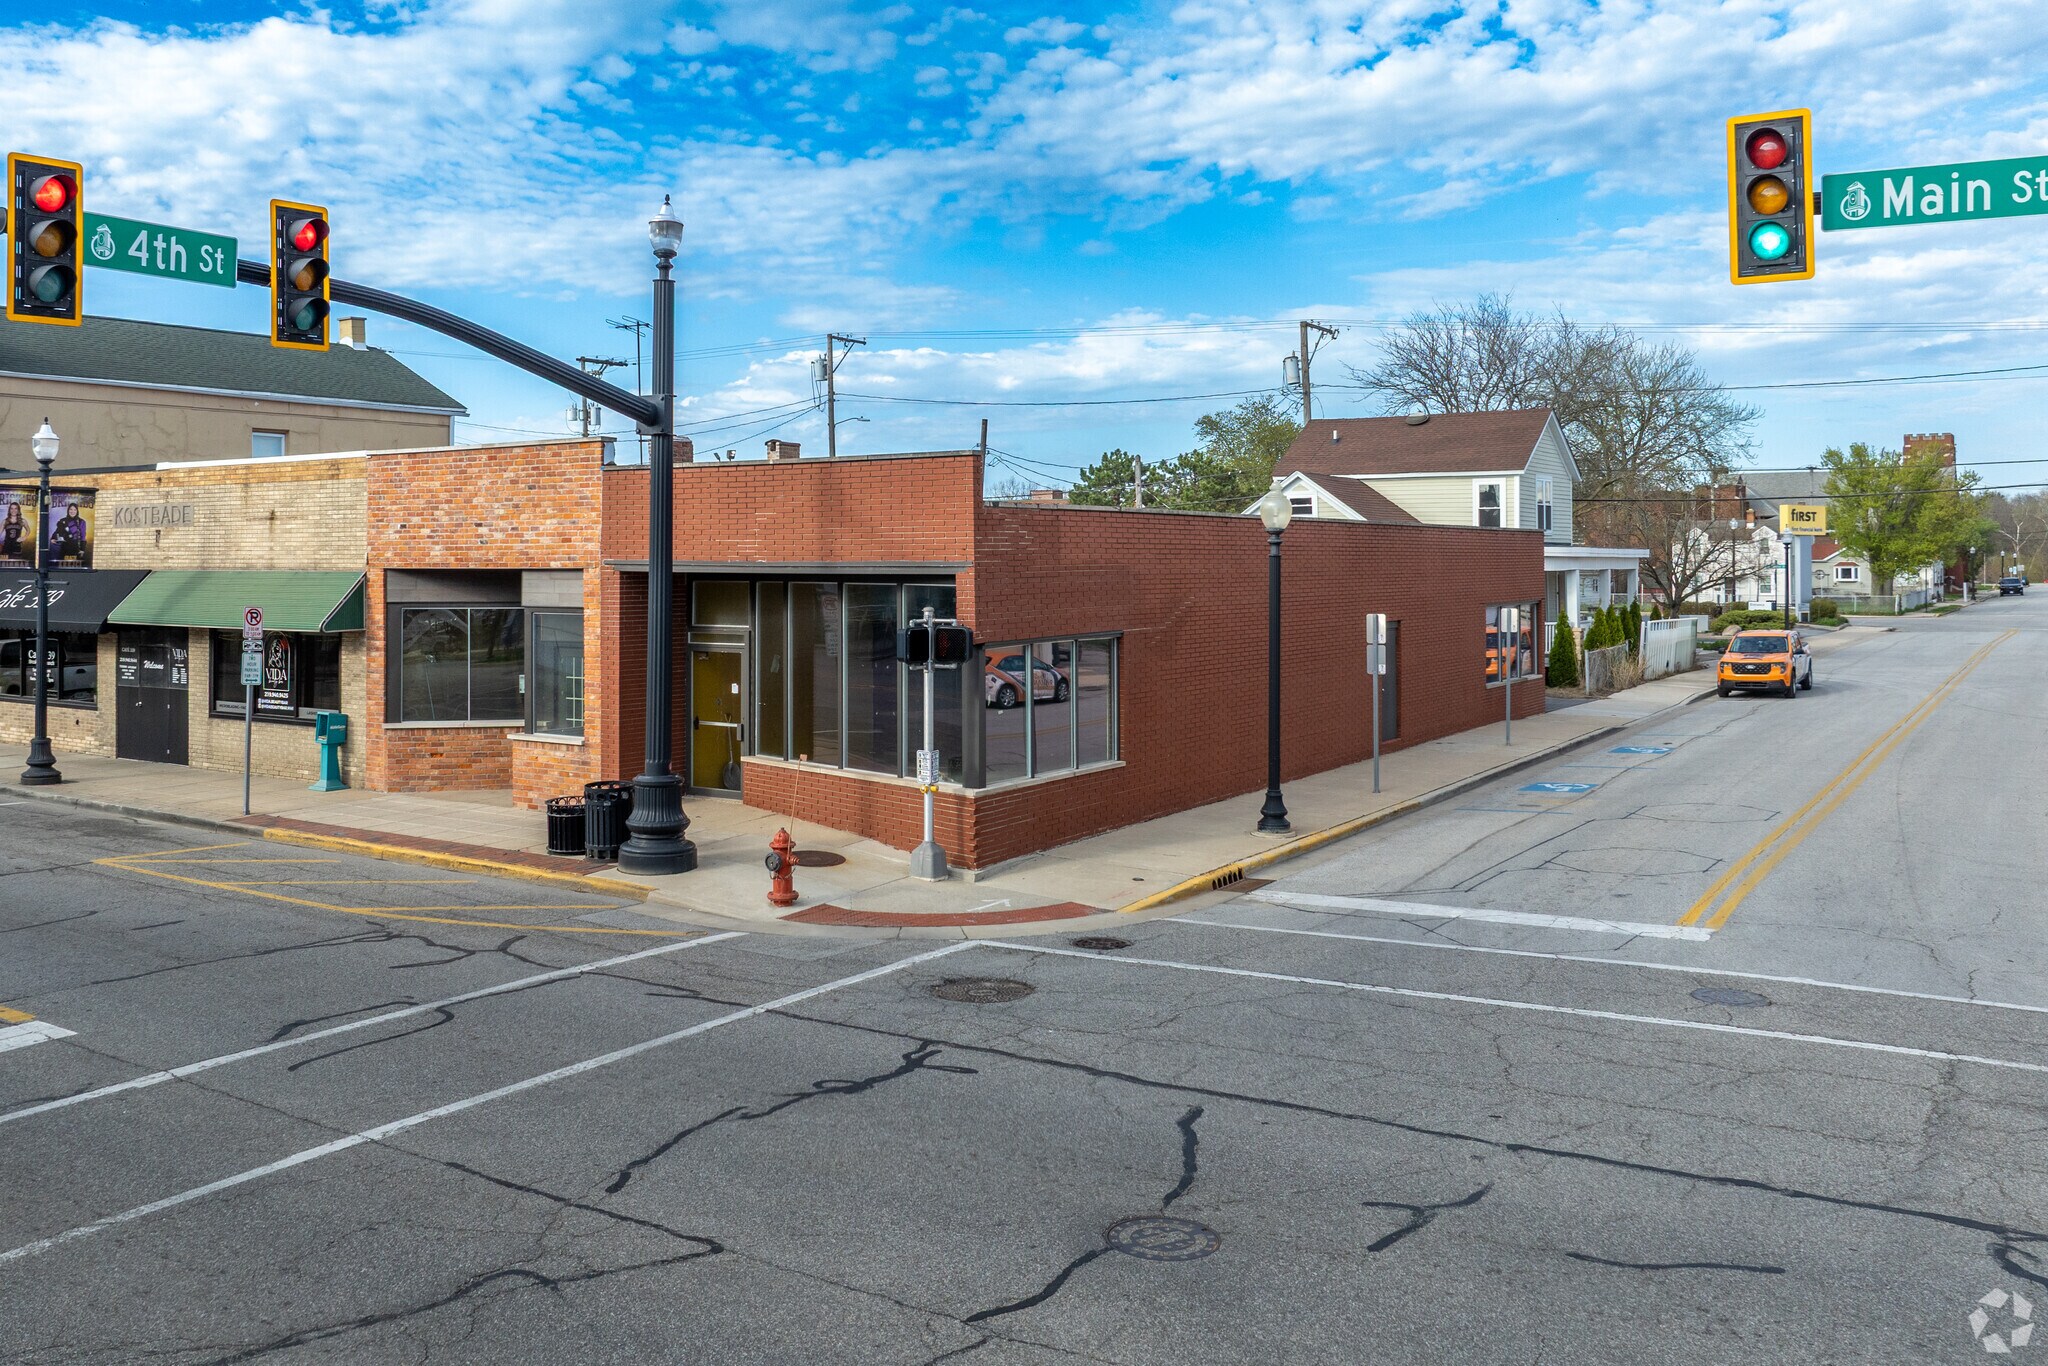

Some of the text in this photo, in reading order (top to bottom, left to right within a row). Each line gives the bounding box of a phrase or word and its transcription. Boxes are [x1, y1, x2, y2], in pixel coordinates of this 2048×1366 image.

[1883, 172, 1992, 219] Main
[128, 229, 225, 275] 4th St
[265, 668, 287, 681] VIDA
